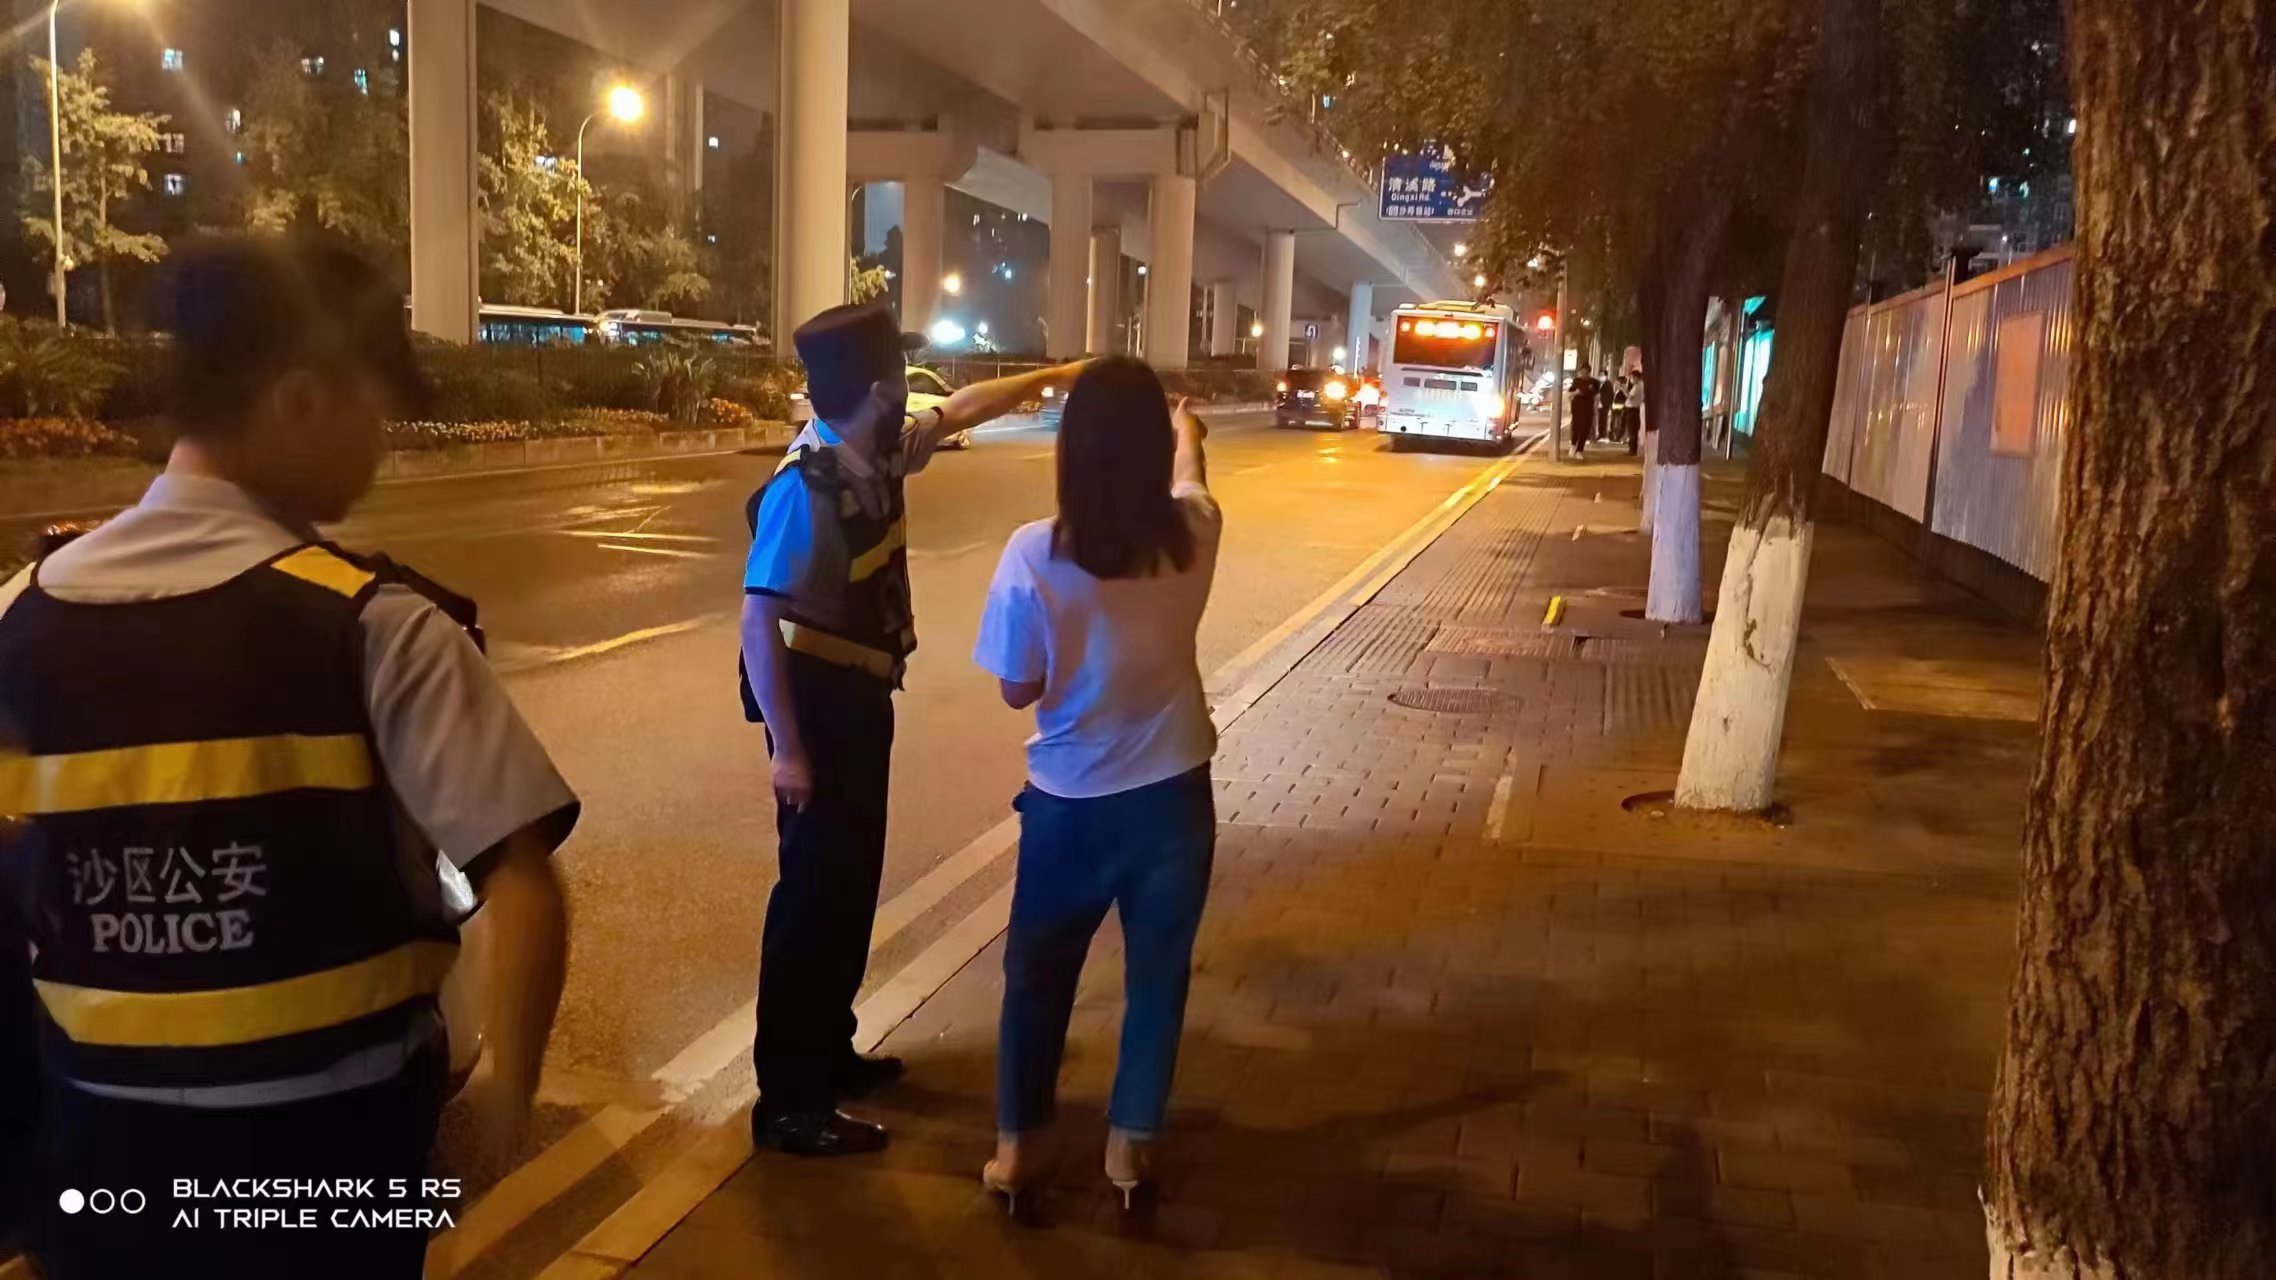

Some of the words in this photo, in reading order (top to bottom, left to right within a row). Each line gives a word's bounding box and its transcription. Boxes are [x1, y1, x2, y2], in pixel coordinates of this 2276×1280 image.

[66, 841, 268, 905] 沙区公安
[91, 909, 255, 954] POLICE
